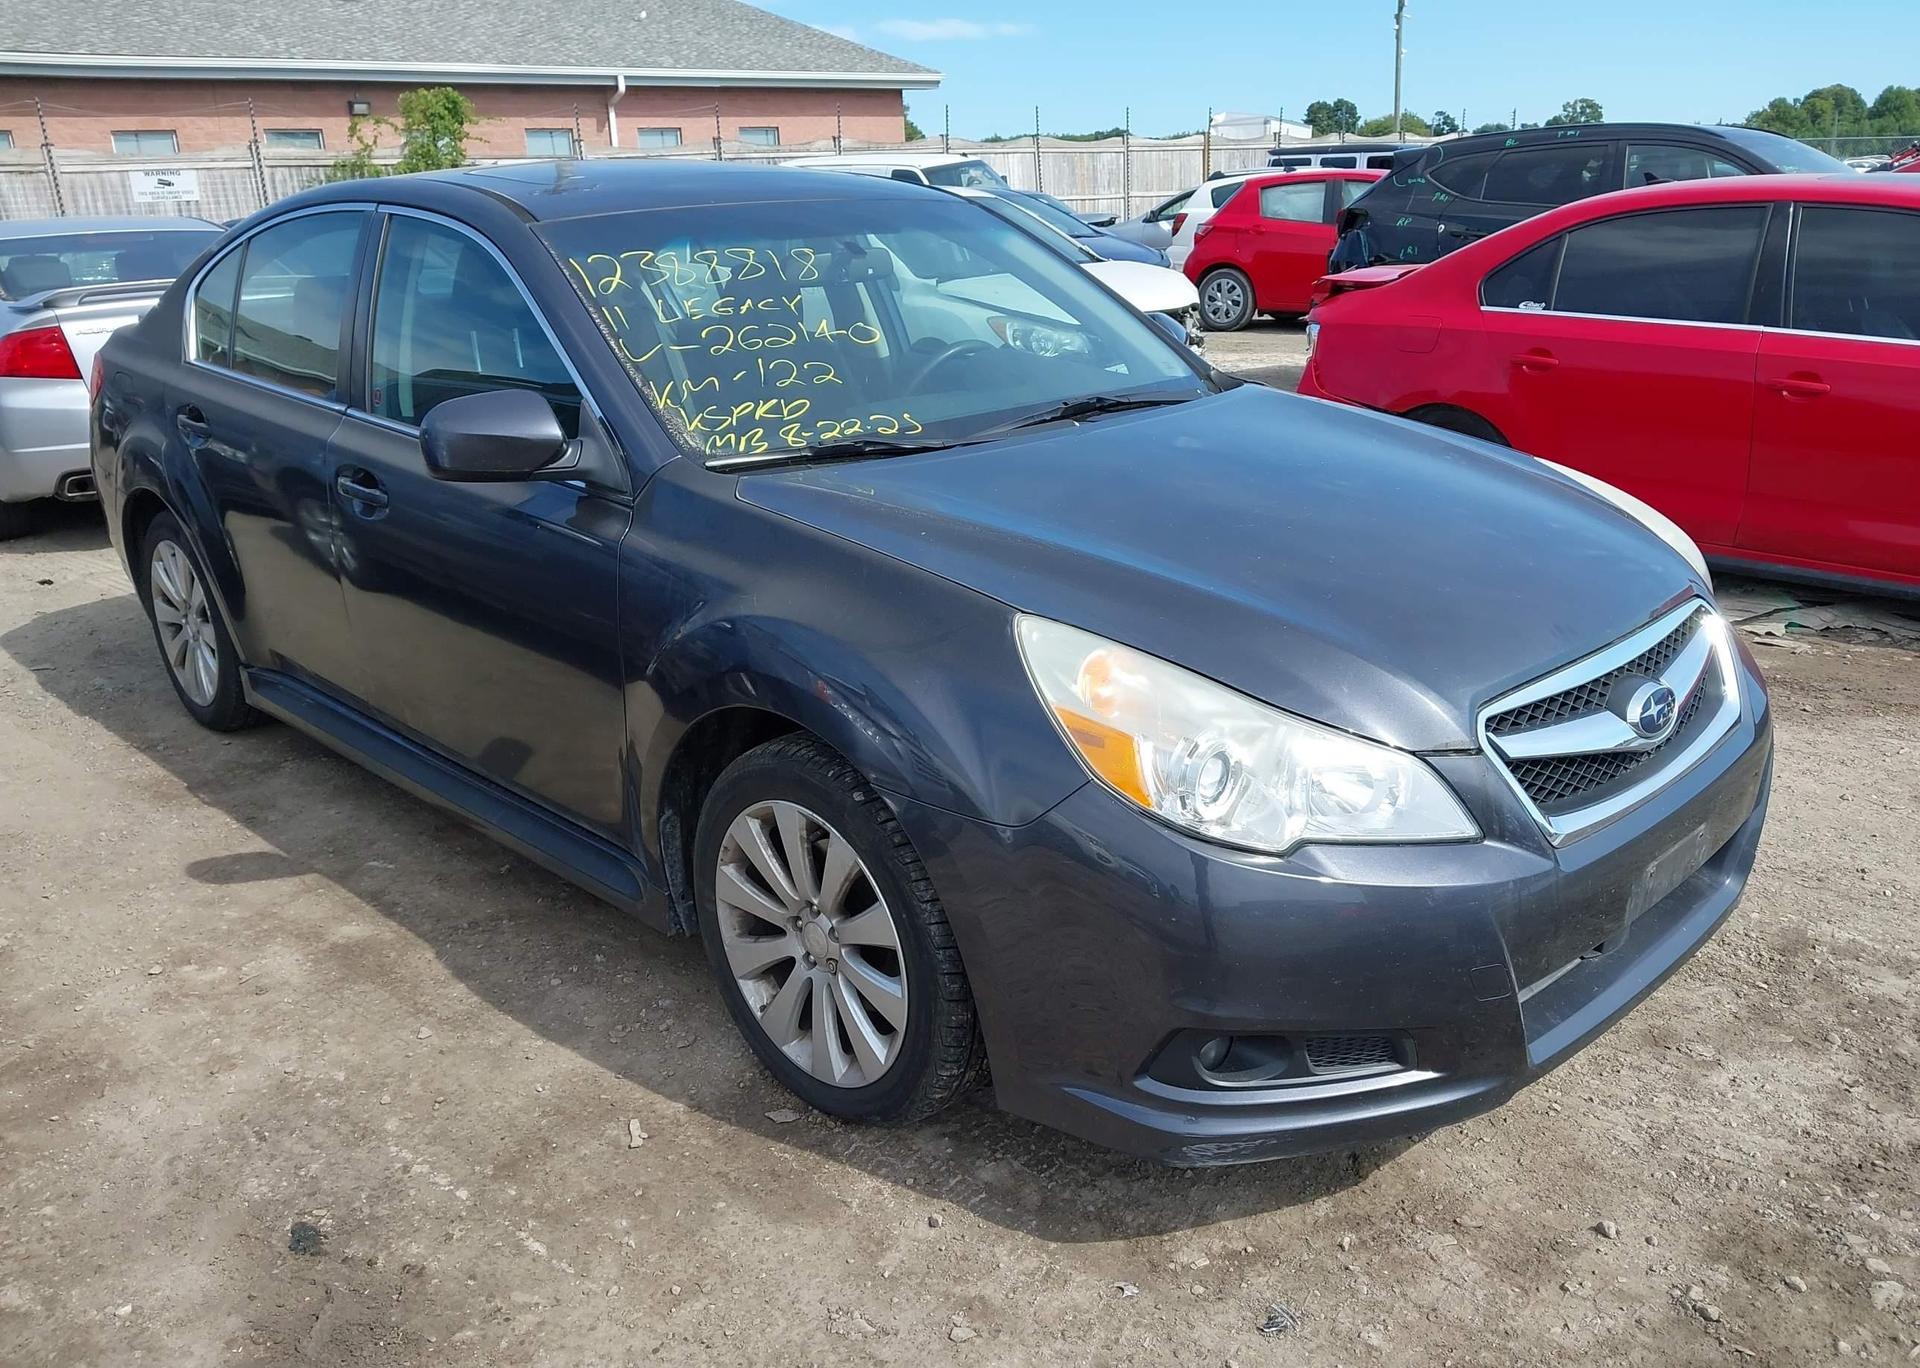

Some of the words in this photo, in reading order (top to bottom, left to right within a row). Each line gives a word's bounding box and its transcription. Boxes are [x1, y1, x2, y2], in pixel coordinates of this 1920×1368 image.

[143, 168, 181, 177] WARNING
[569, 247, 819, 299] 12388818
[657, 294, 802, 323] LEGACY
